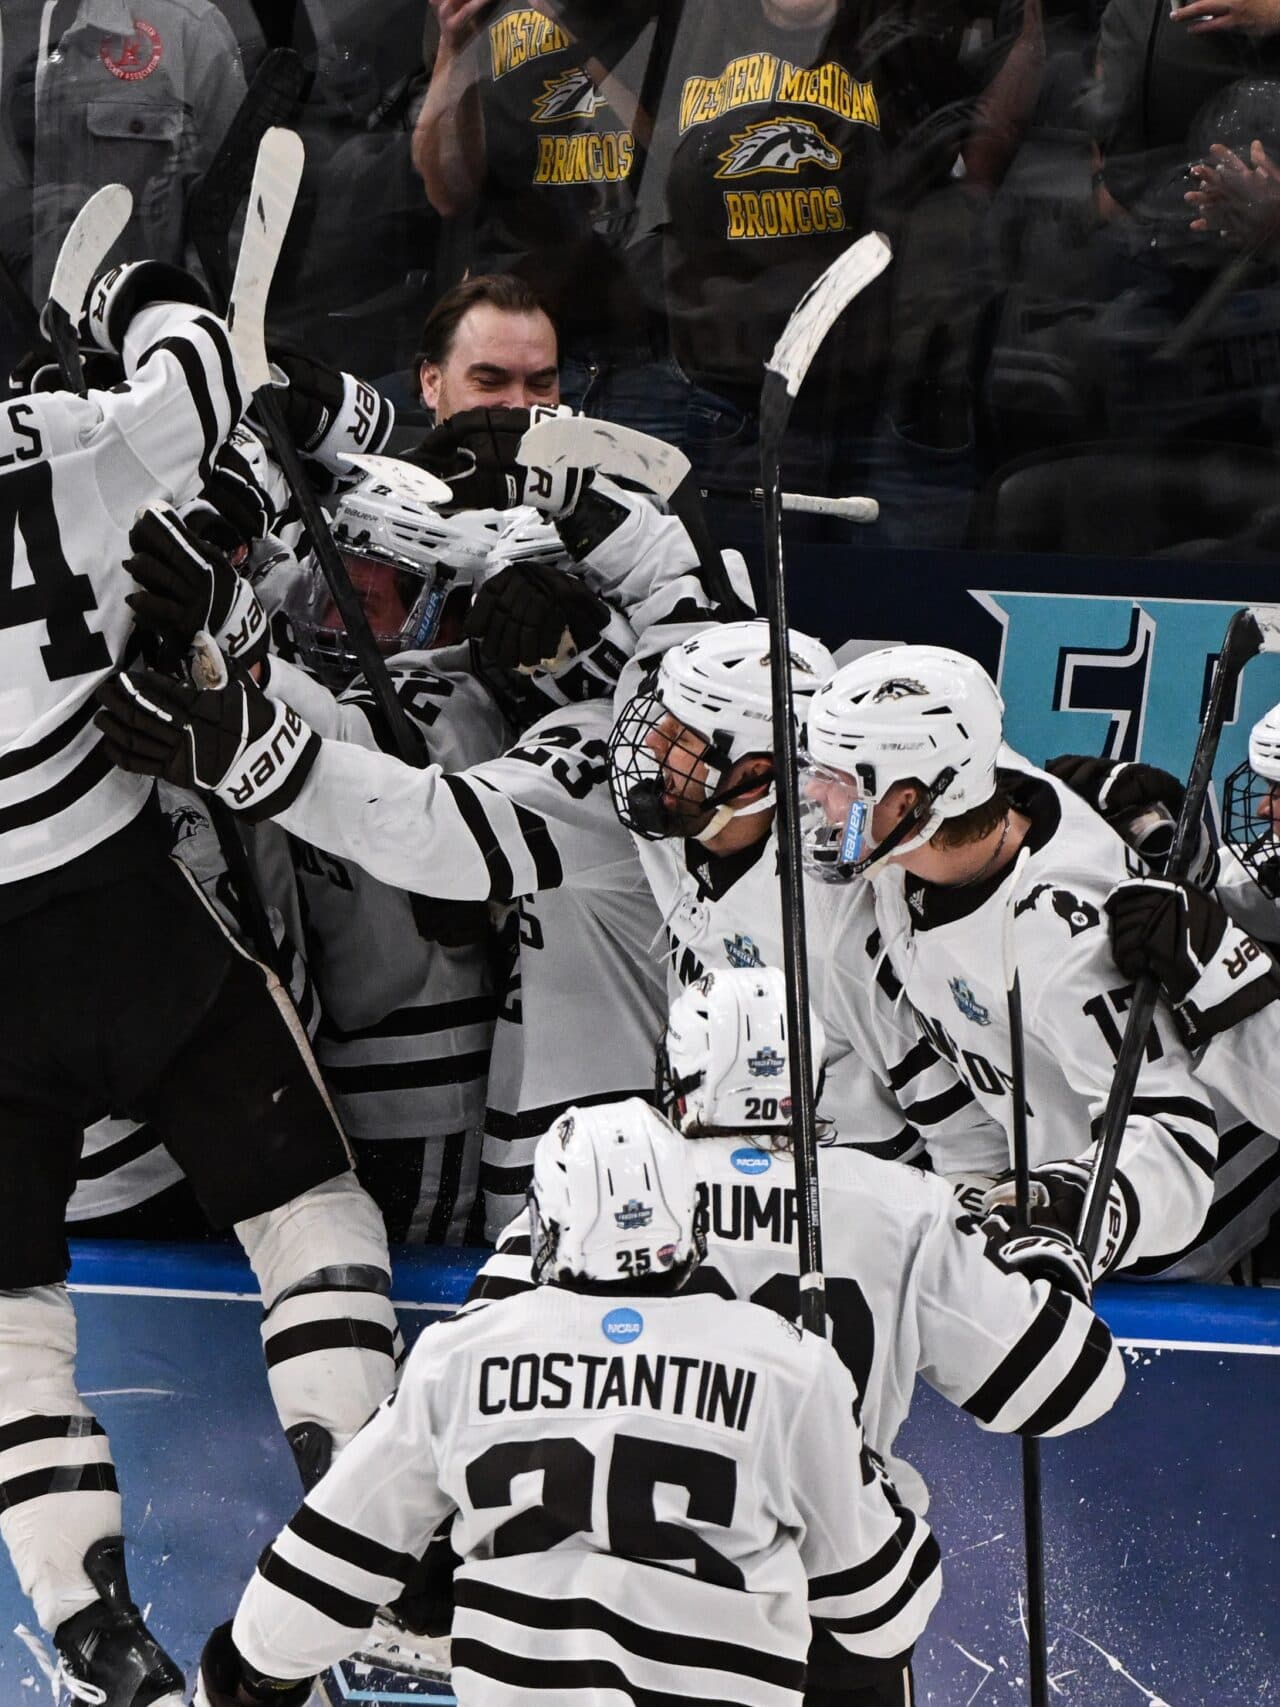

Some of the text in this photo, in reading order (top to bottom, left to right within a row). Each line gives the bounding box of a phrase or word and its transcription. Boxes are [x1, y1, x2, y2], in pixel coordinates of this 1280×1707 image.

[679, 52, 880, 136] WESTERN MICHIGAN
[533, 131, 635, 185] BRONCOS
[724, 186, 846, 240] BRONCOS
[417, 592, 440, 641] AUER
[228, 703, 302, 804] AUER
[844, 802, 863, 862] BAUER
[745, 1097, 777, 1120] 20
[735, 1157, 769, 1168] NCAA
[616, 1247, 651, 1274] 25
[608, 1323, 640, 1334] NCAA
[479, 1353, 756, 1432] COSTANTINI
